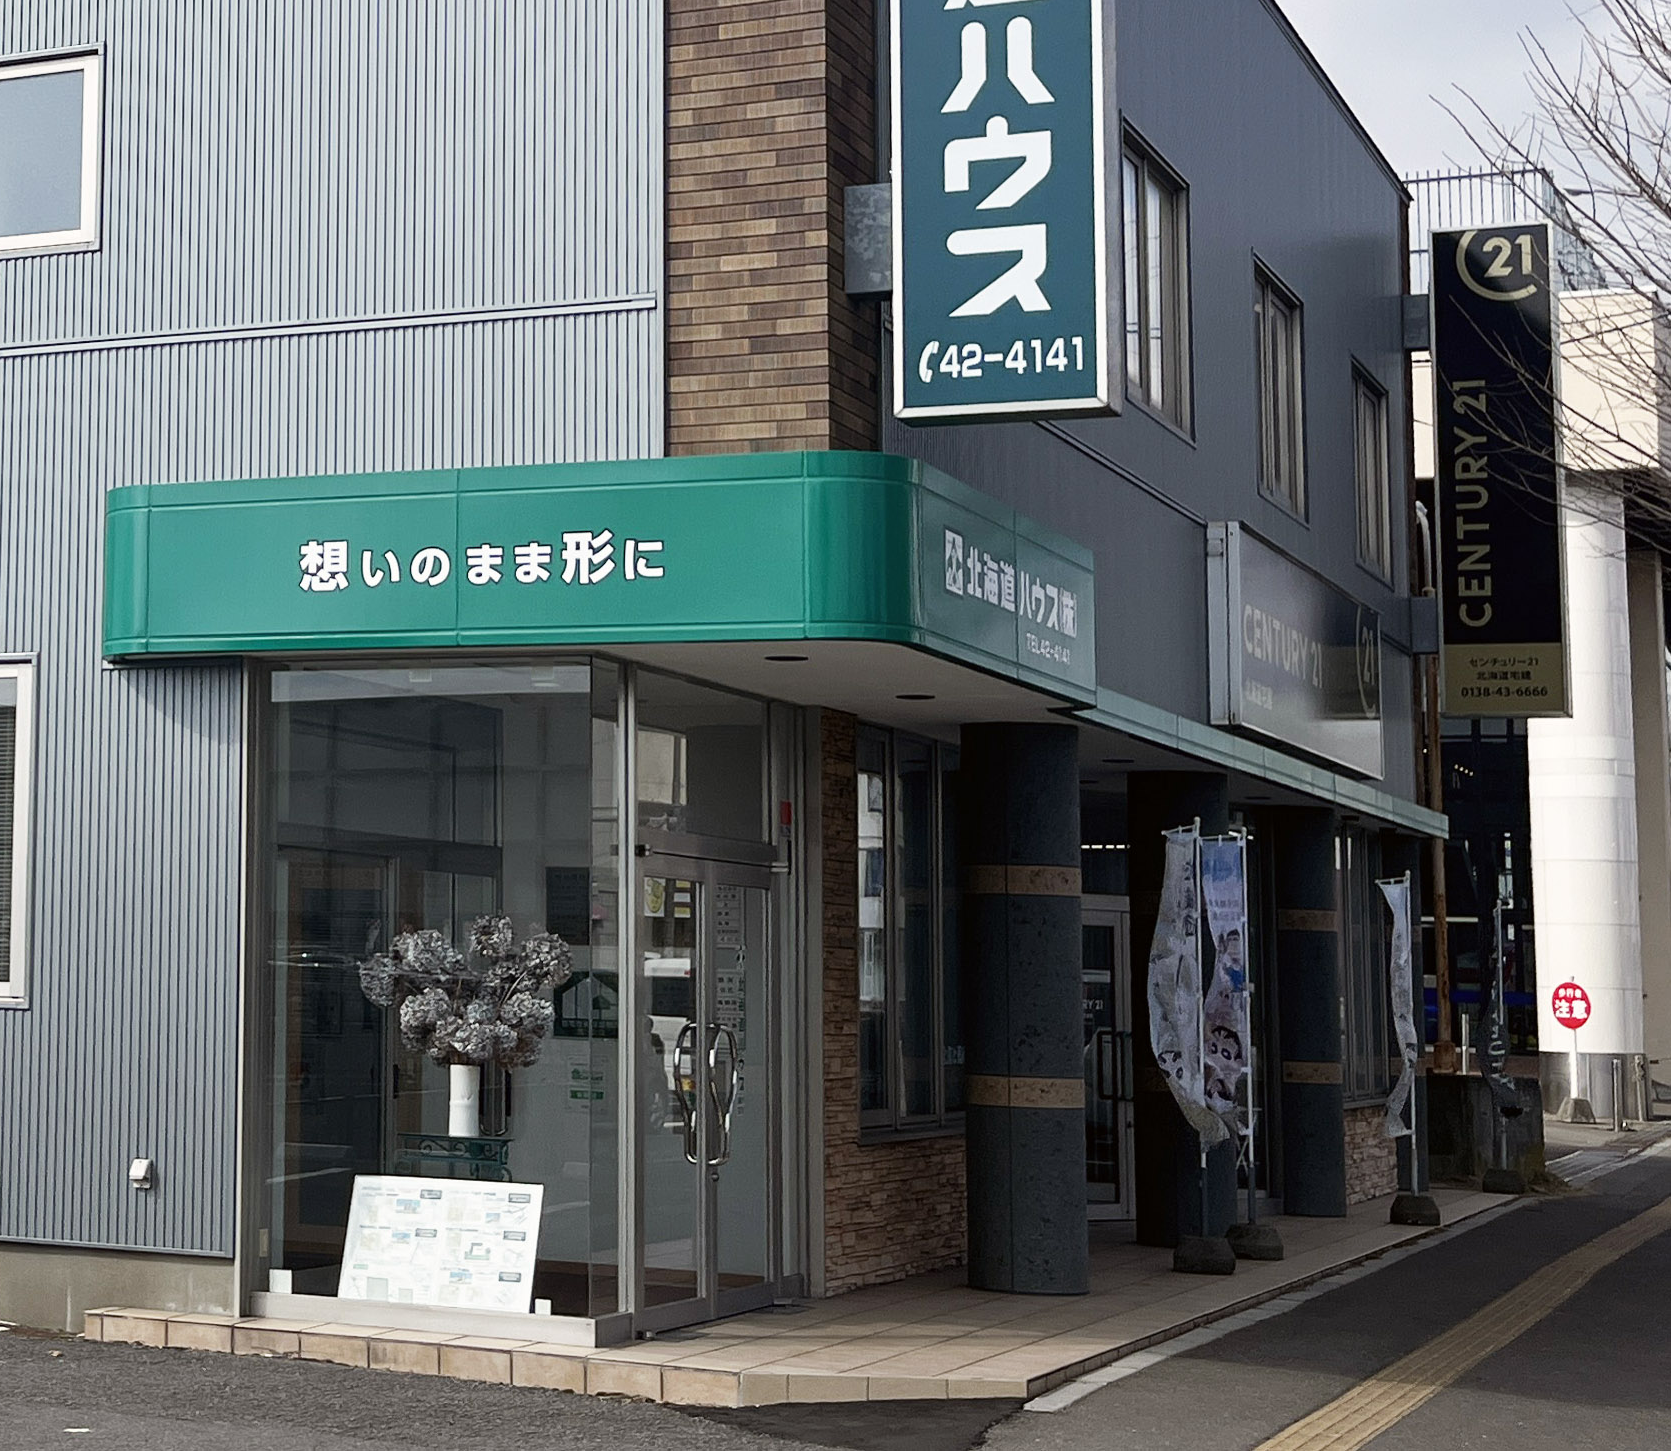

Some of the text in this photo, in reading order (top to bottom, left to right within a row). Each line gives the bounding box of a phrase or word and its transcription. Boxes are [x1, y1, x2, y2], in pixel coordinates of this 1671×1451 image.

[939, 335, 1084, 379] 42-4141
[1452, 379, 1492, 627] CENTURY 21
[299, 529, 665, 592] 想いのまま形に
[1244, 604, 1309, 681] CENTURY
[1554, 999, 1588, 1020] 注意
